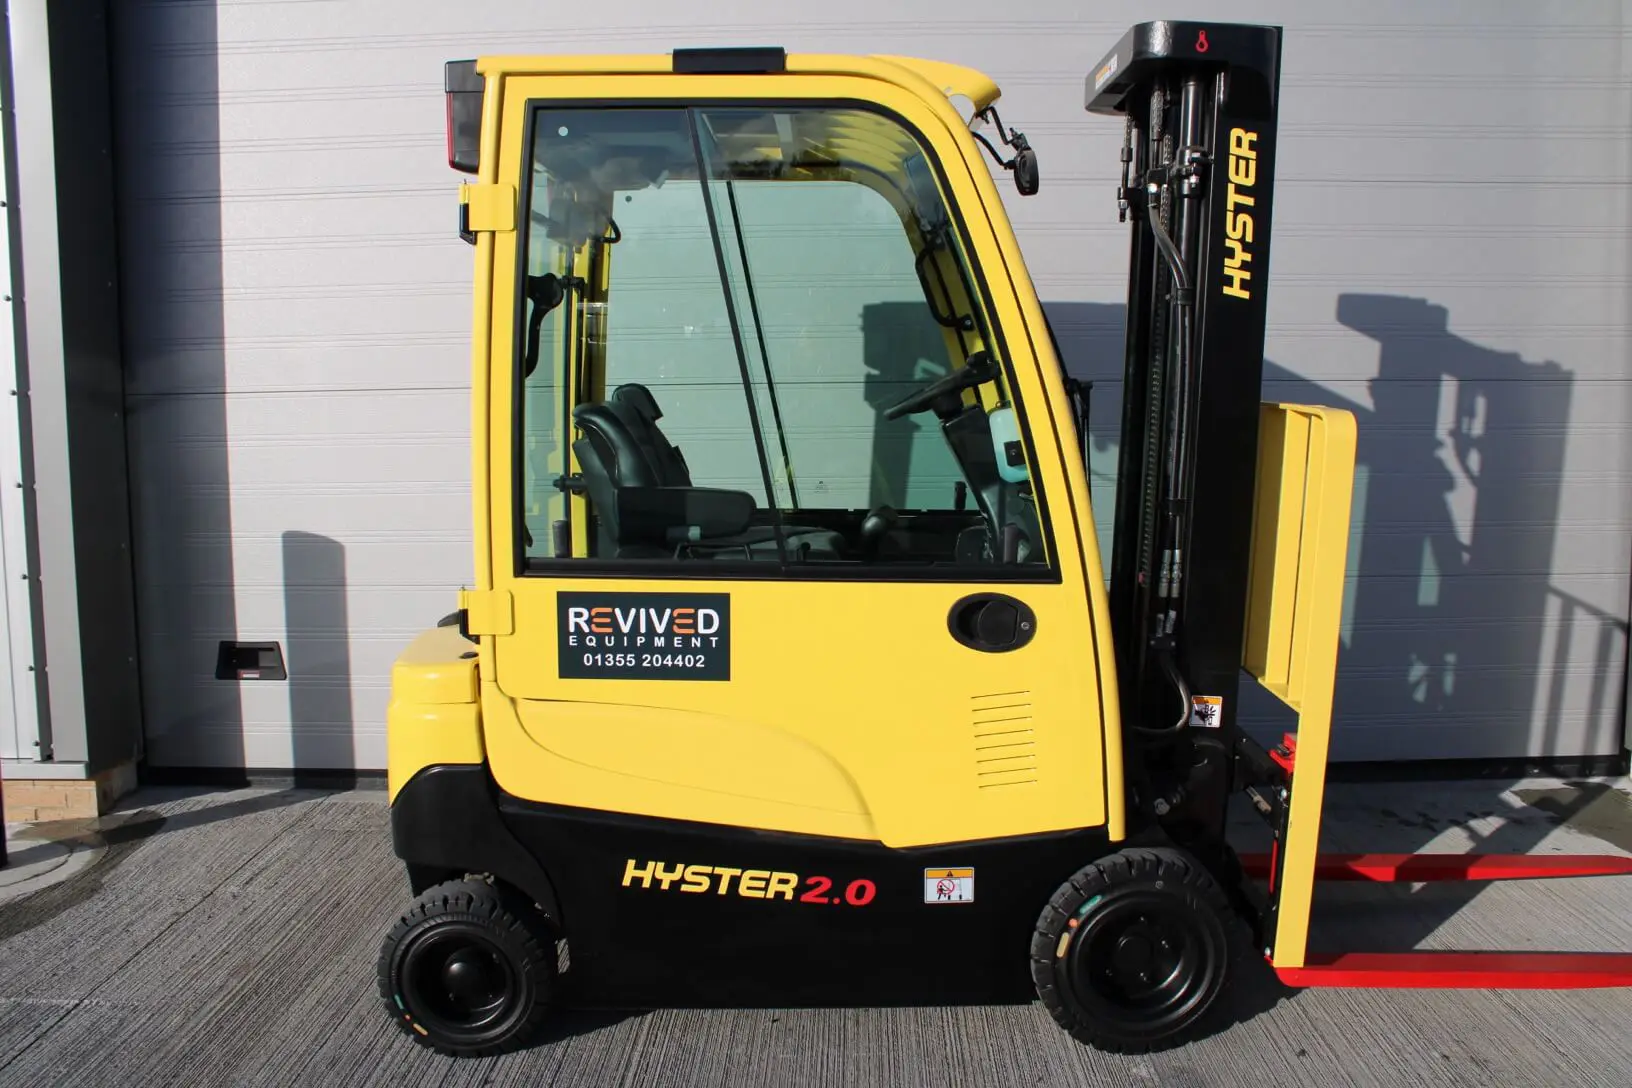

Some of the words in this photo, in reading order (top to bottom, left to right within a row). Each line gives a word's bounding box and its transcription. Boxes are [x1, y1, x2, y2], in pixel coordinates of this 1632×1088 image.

[1222, 127, 1258, 300] HYSTER
[568, 607, 720, 634] REVIVED
[569, 635, 719, 648] EQUIPMENT
[583, 653, 636, 666] 01355
[642, 653, 705, 667] 204402
[622, 859, 799, 900] HYSTER
[800, 876, 876, 906] 2.0
